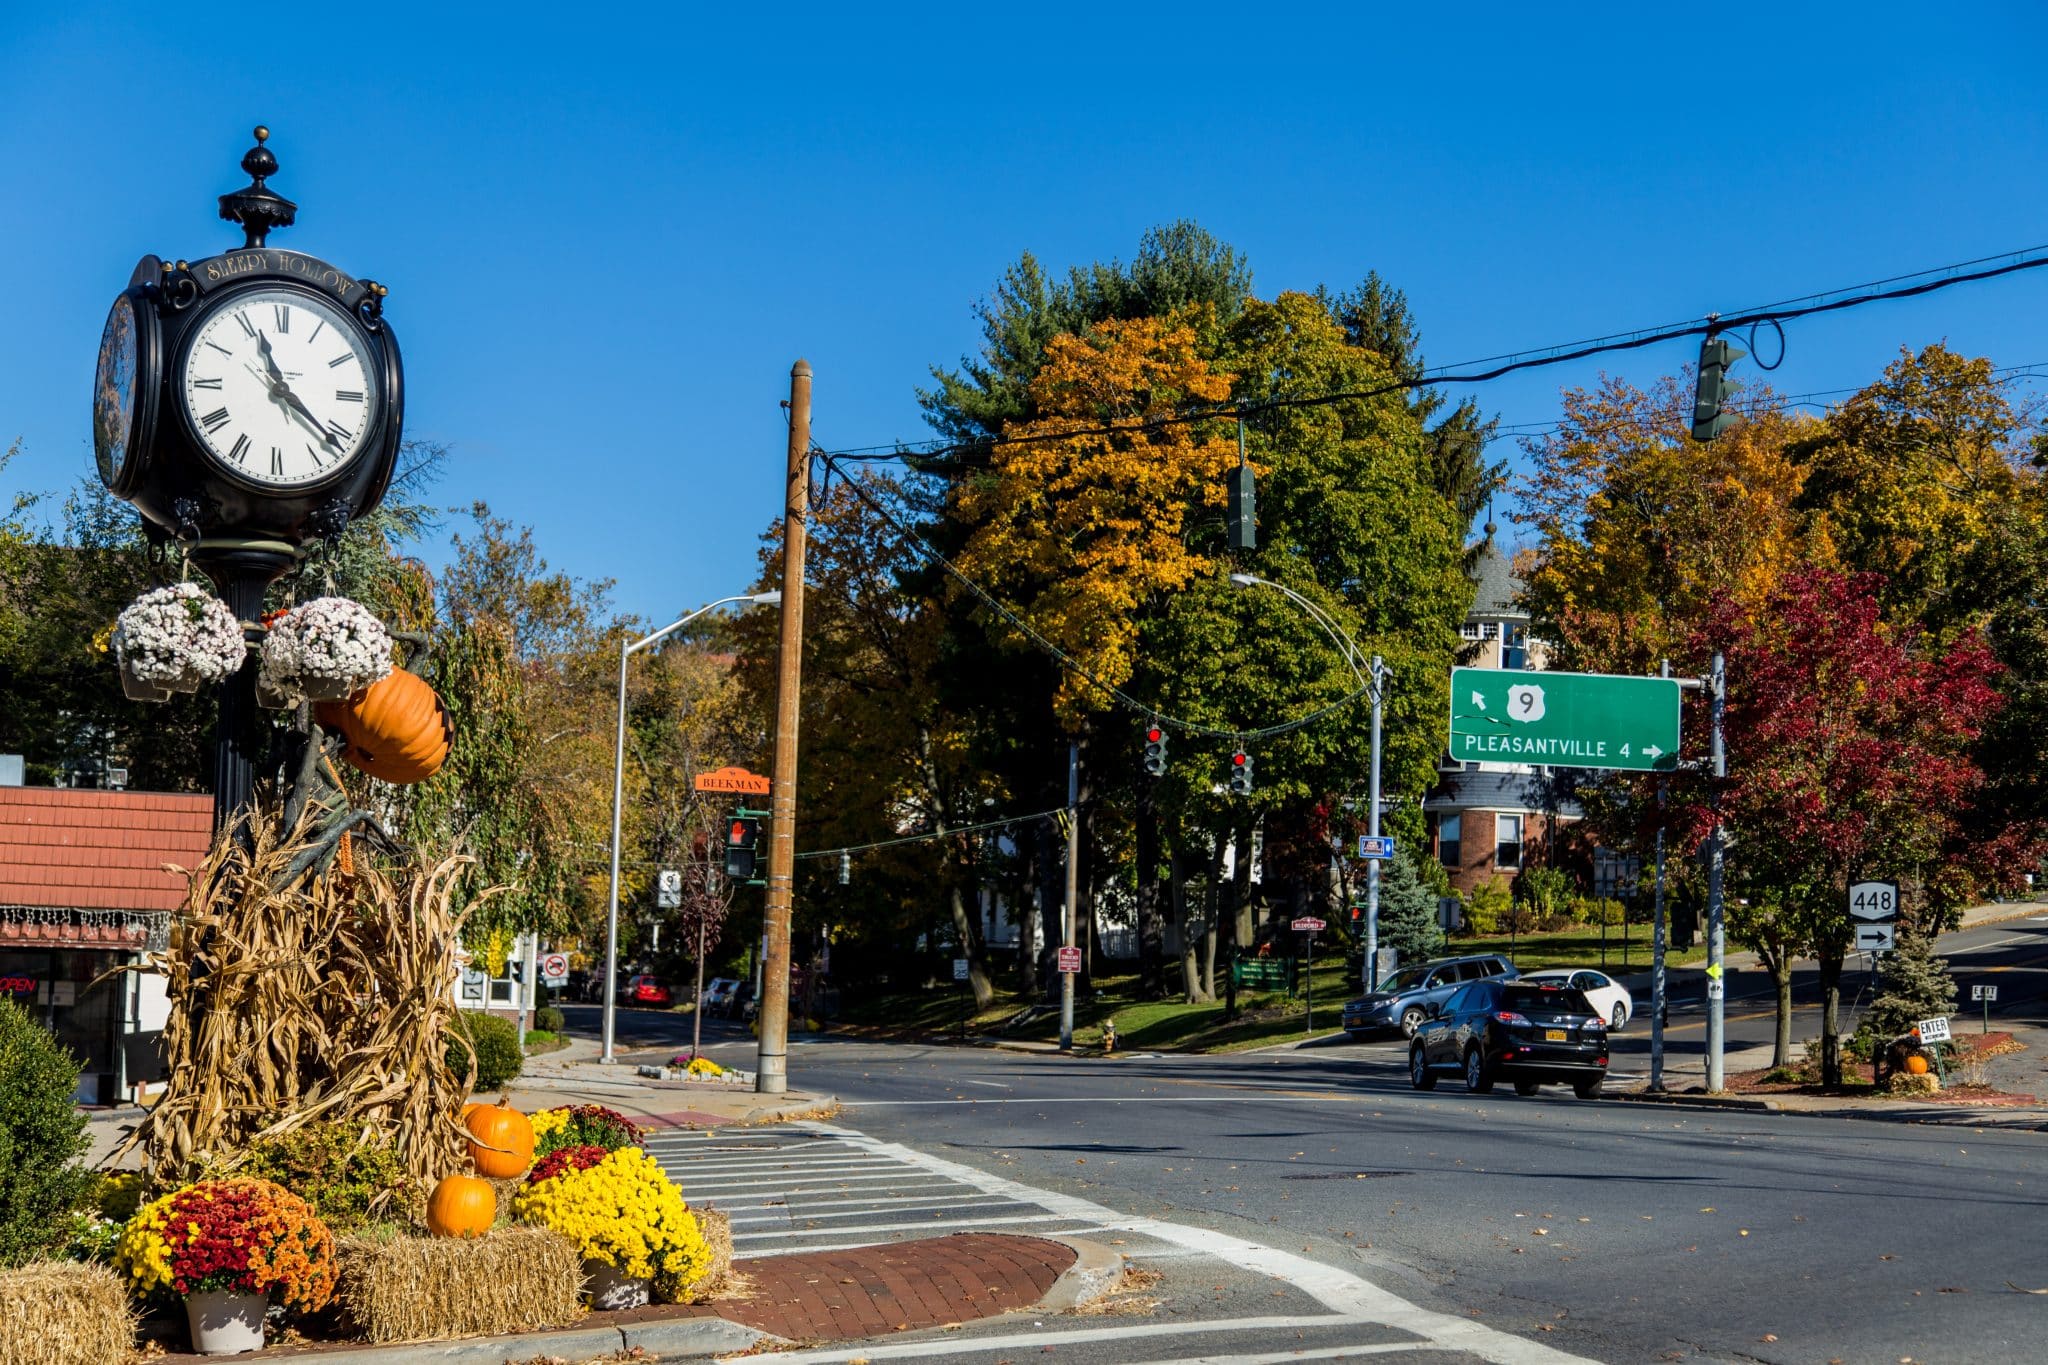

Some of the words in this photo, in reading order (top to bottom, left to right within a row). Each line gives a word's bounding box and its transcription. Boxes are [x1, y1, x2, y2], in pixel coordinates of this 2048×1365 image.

[207, 254, 269, 281] SLEEPY
[280, 254, 354, 296] HOLLOW
[235, 311, 258, 341] XI
[273, 304, 290, 334] XII
[205, 337, 233, 360] X
[336, 390, 364, 403] III
[200, 406, 232, 435] VIII
[229, 432, 252, 464] VII
[306, 443, 322, 467] V
[271, 446, 283, 476] VI
[1519, 692, 1534, 714] 9
[1466, 735, 1607, 757] PLEASANTVILLE
[1619, 743, 1630, 758] 4
[703, 778, 762, 790] BEEKMAN
[667, 875, 674, 887] 9
[1853, 891, 1891, 910] 448
[0, 977, 37, 992] OPEN
[469, 970, 476, 980] 9
[1920, 1019, 1947, 1034] ENTER
